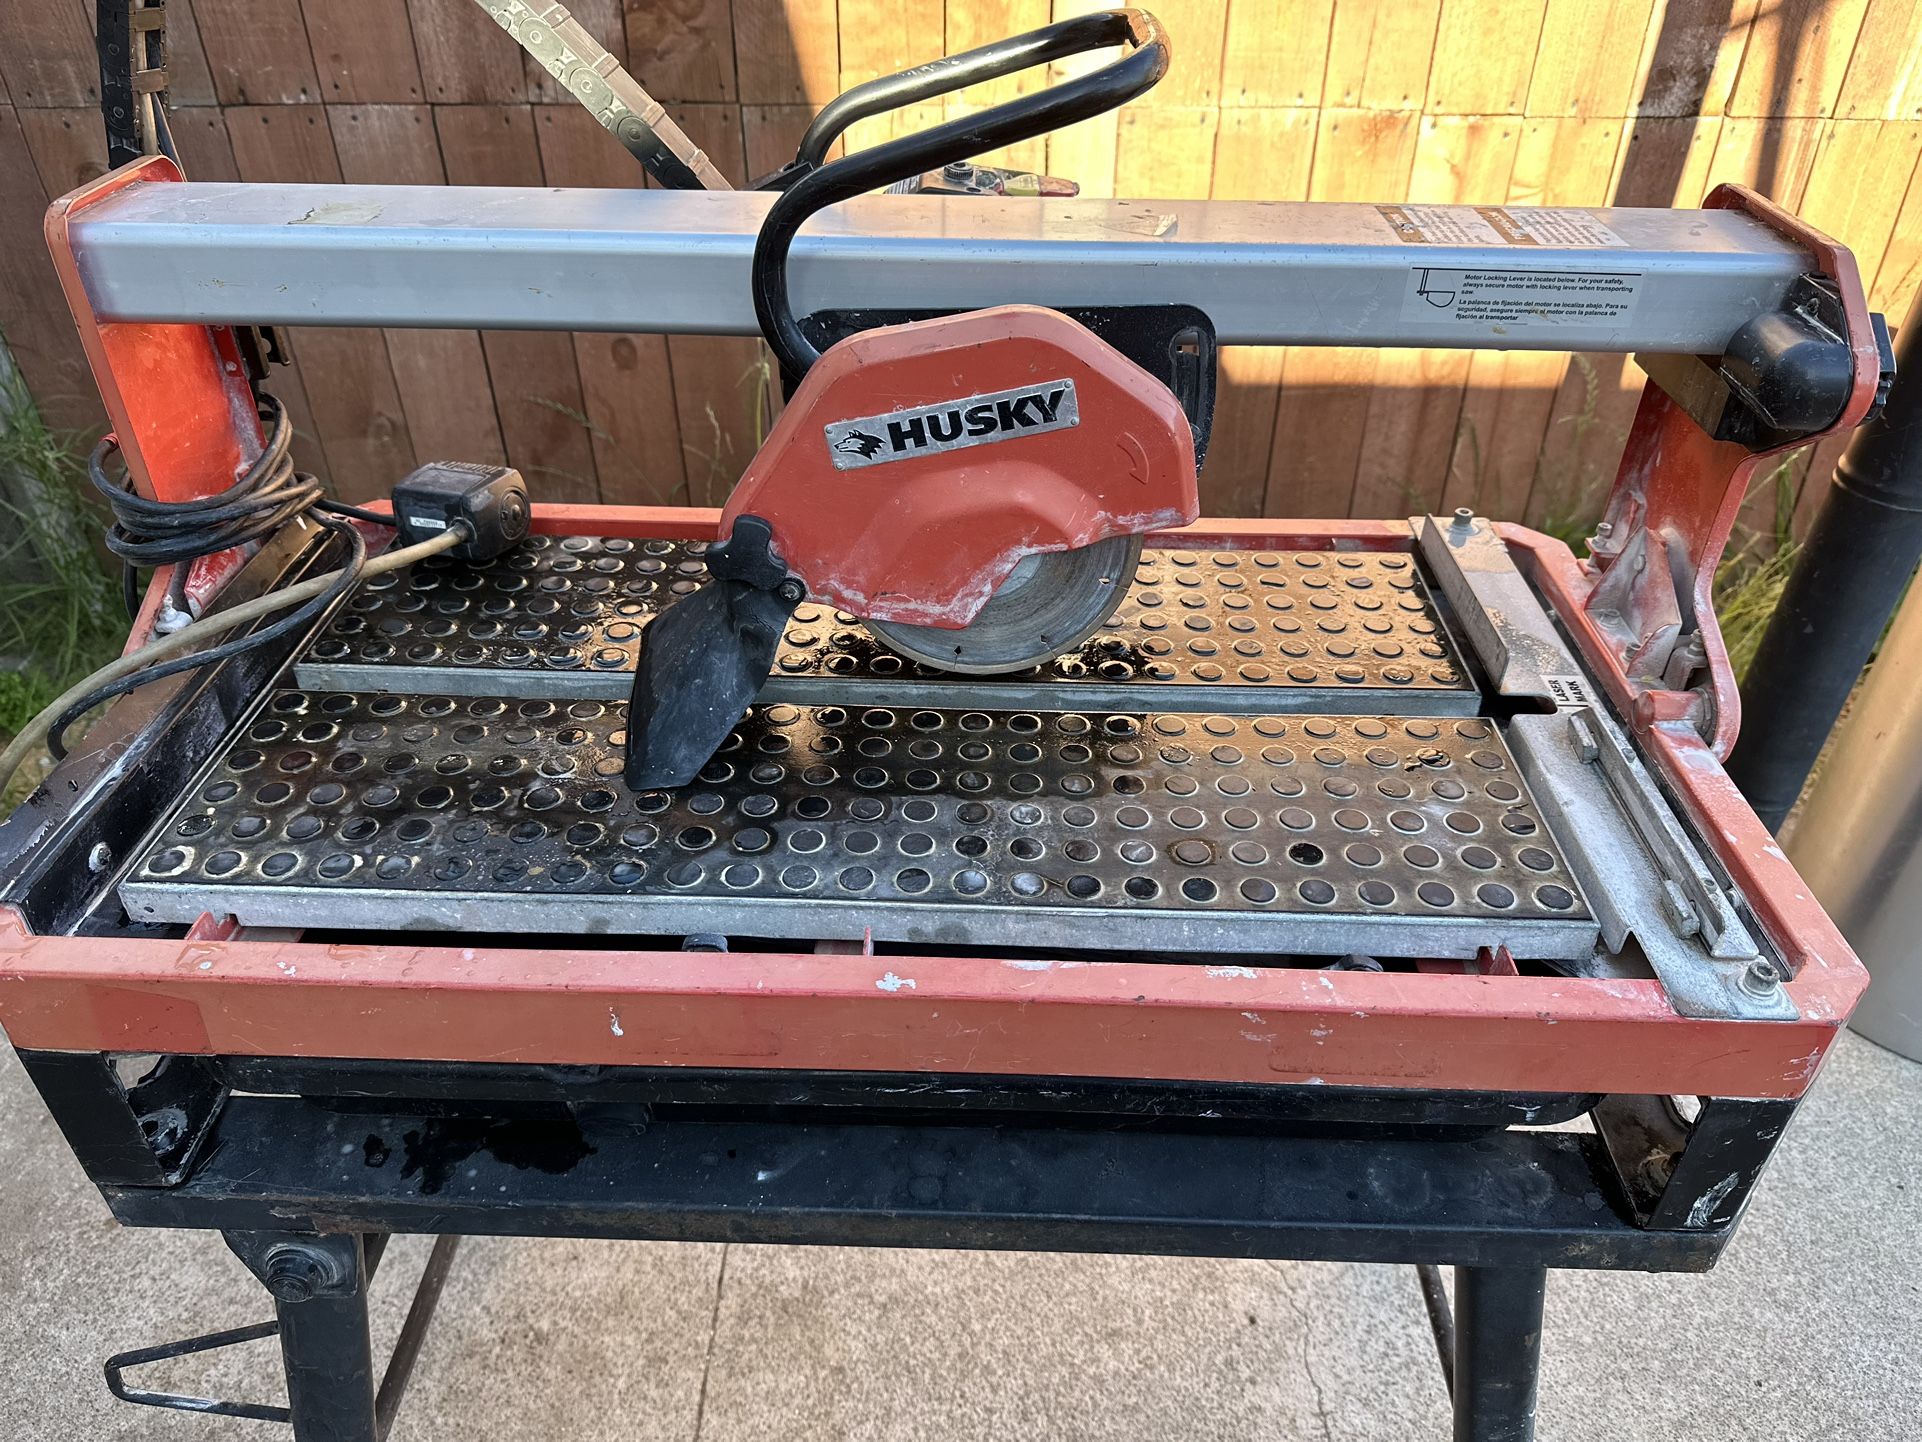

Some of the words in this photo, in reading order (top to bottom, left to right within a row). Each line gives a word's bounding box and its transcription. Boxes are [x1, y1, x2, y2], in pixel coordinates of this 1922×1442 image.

[1462, 281, 1483, 289] always
[1539, 283, 1562, 291] locking
[1596, 285, 1633, 293] transporting
[886, 389, 1066, 452] HUSKY
[1548, 679, 1570, 702] LASER
[1565, 680, 1588, 703] MARK
